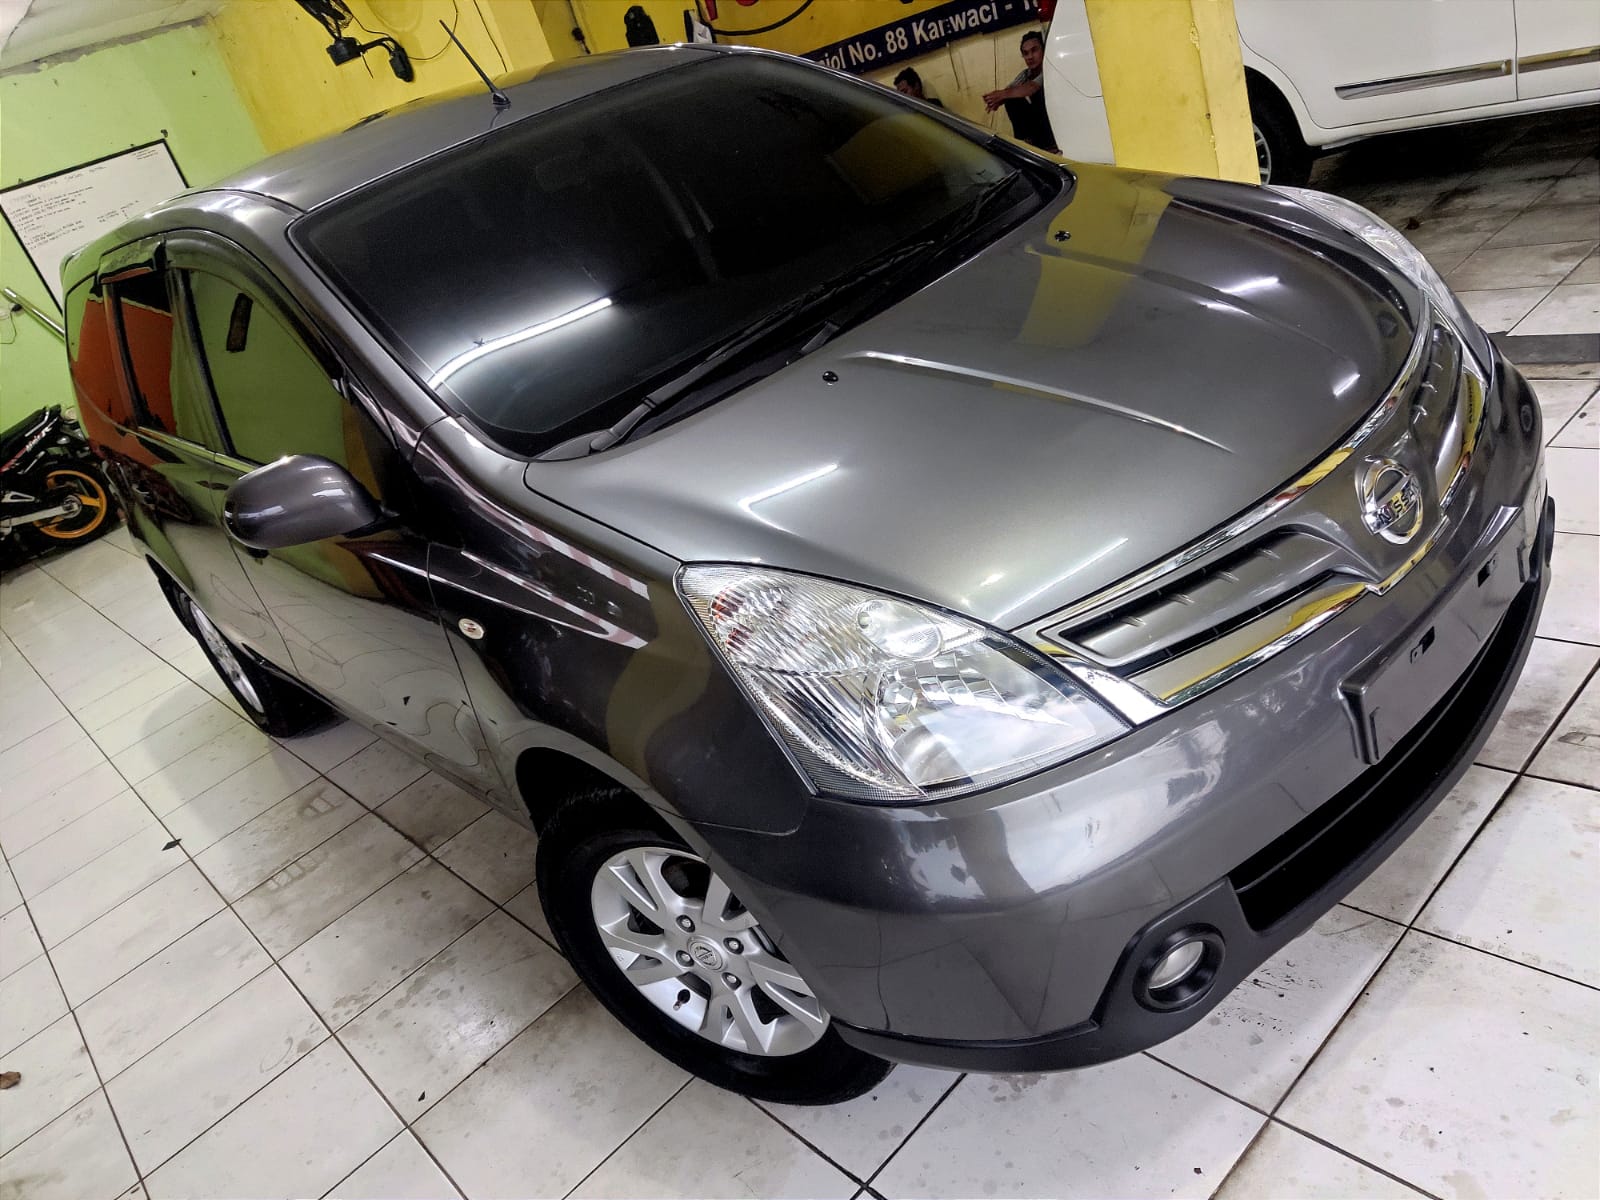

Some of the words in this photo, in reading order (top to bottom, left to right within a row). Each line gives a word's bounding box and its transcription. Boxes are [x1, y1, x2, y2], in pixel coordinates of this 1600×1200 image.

[848, 41, 882, 66] No.
[885, 27, 908, 54] 88
[912, 0, 999, 45] Karwaci
[1376, 477, 1420, 525] NISSAN
